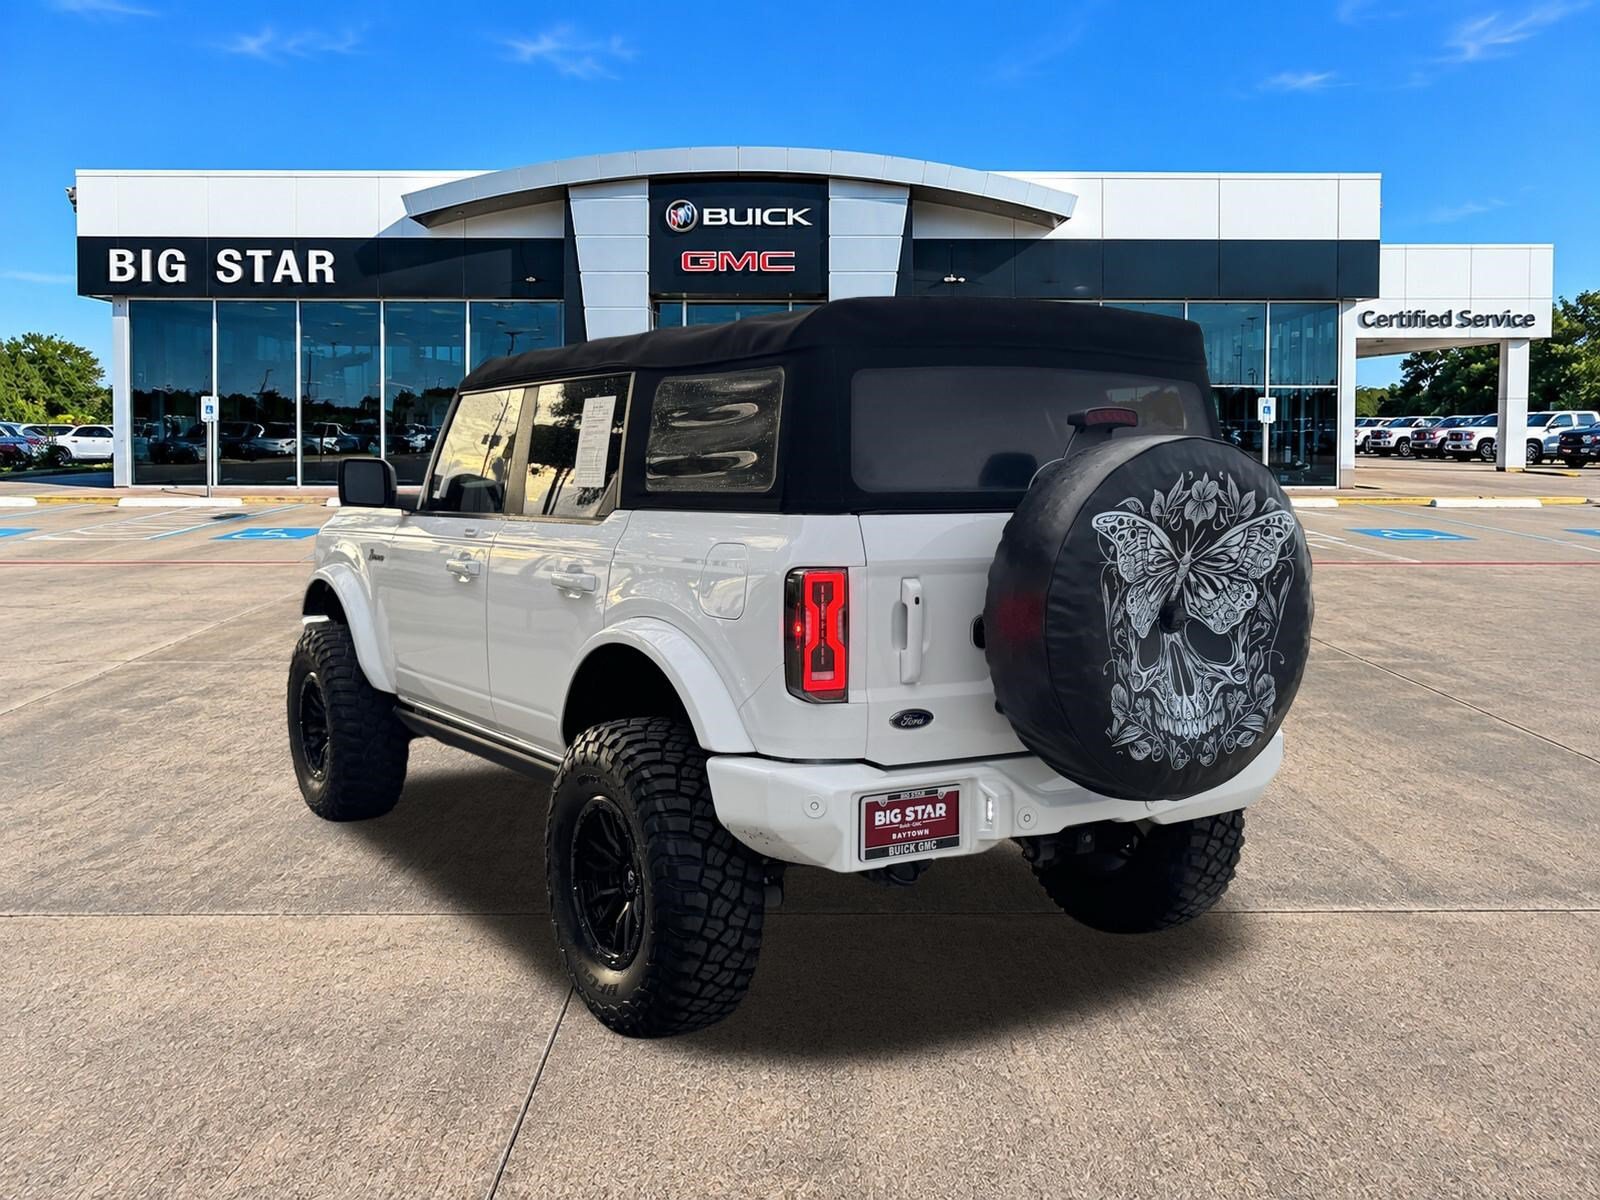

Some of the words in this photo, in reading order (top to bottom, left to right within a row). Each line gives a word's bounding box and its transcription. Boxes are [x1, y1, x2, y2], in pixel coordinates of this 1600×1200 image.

[702, 207, 812, 226] BUICK
[108, 248, 187, 283] BIG
[216, 248, 336, 284] STAR
[681, 250, 796, 272] GMC
[1359, 309, 1453, 329] Certified
[1455, 309, 1536, 328] Service
[900, 714, 925, 727] Ford
[875, 809, 902, 826] BIG
[905, 803, 947, 821] STAR
[892, 829, 929, 839] BAYTOWN
[888, 843, 917, 856] BUICK
[918, 840, 937, 851] GMC
